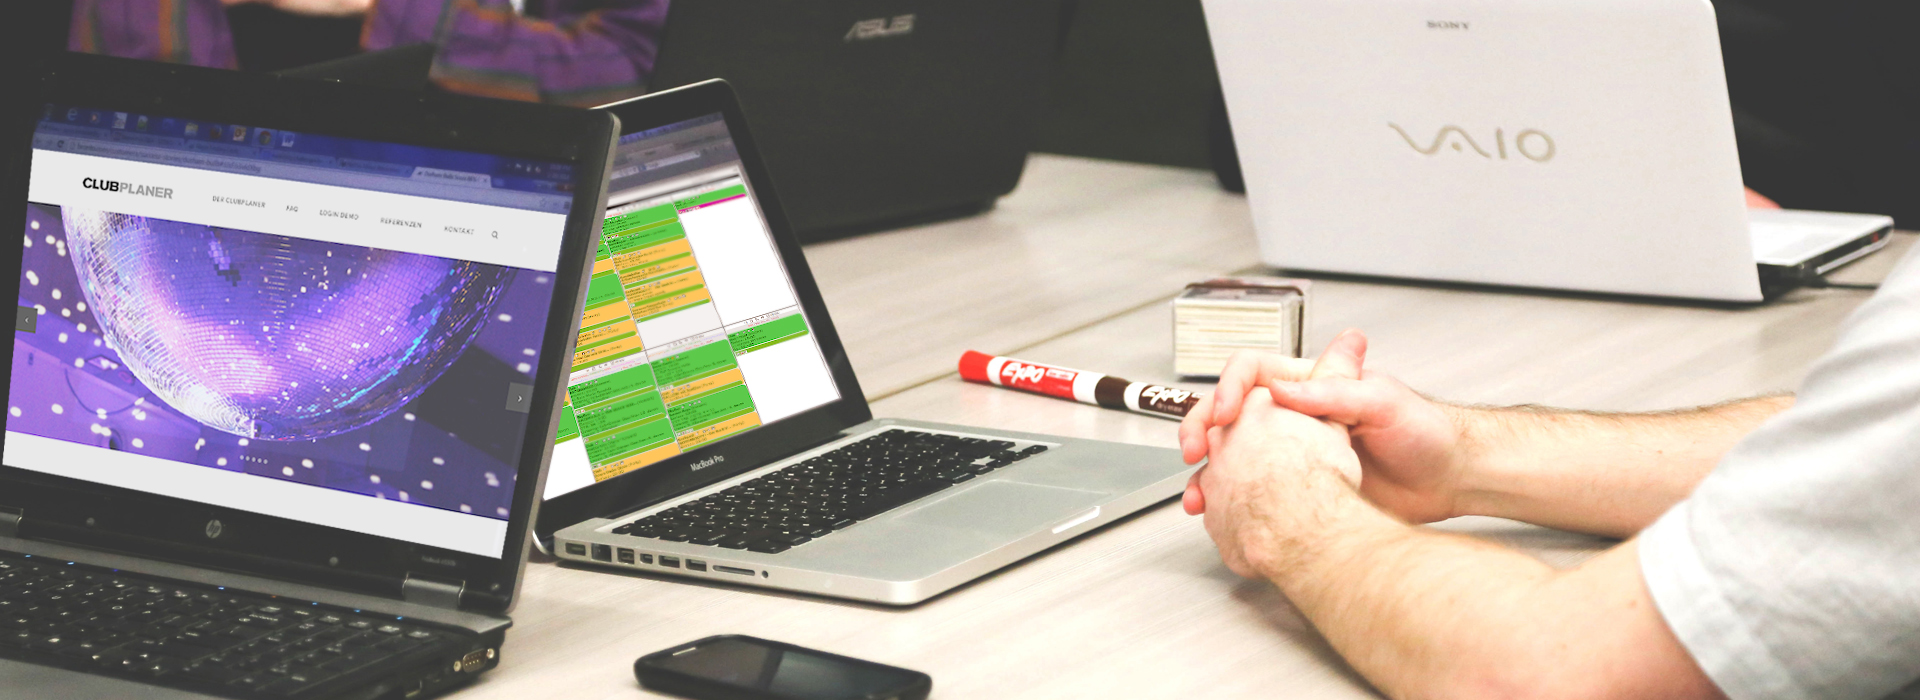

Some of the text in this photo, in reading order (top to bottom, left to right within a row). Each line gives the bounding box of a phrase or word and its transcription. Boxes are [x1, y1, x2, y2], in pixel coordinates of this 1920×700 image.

[843, 13, 916, 42] ASUS
[1426, 20, 1470, 30] SONY
[1387, 121, 1557, 163] VAIO
[82, 177, 174, 199] CLUBPLANER
[212, 195, 266, 208] DER CLUBPLANER
[285, 204, 299, 212] FAQ
[319, 209, 359, 221] LOGIN DEMO
[380, 217, 422, 228] REFERENZEN
[444, 225, 475, 235] KONTAKT
[1001, 362, 1045, 385] EXPO
[1141, 385, 1191, 406] EXPO
[690, 455, 725, 471] MacBook Pro
